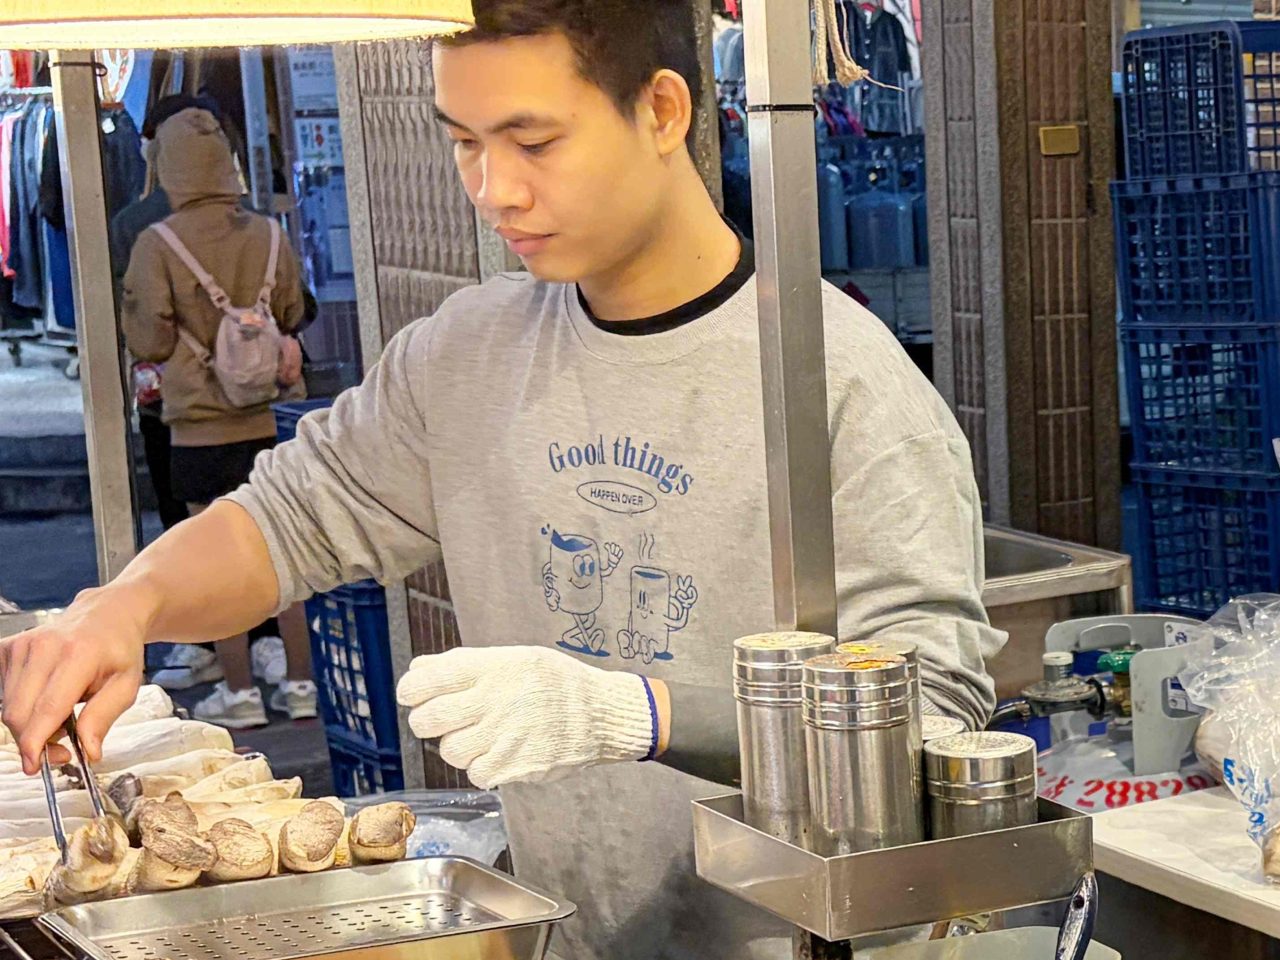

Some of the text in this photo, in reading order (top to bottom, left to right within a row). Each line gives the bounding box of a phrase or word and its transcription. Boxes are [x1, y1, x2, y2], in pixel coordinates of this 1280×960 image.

[548, 434, 695, 496] Good things
[590, 487, 643, 506] HAPPEN OVER
